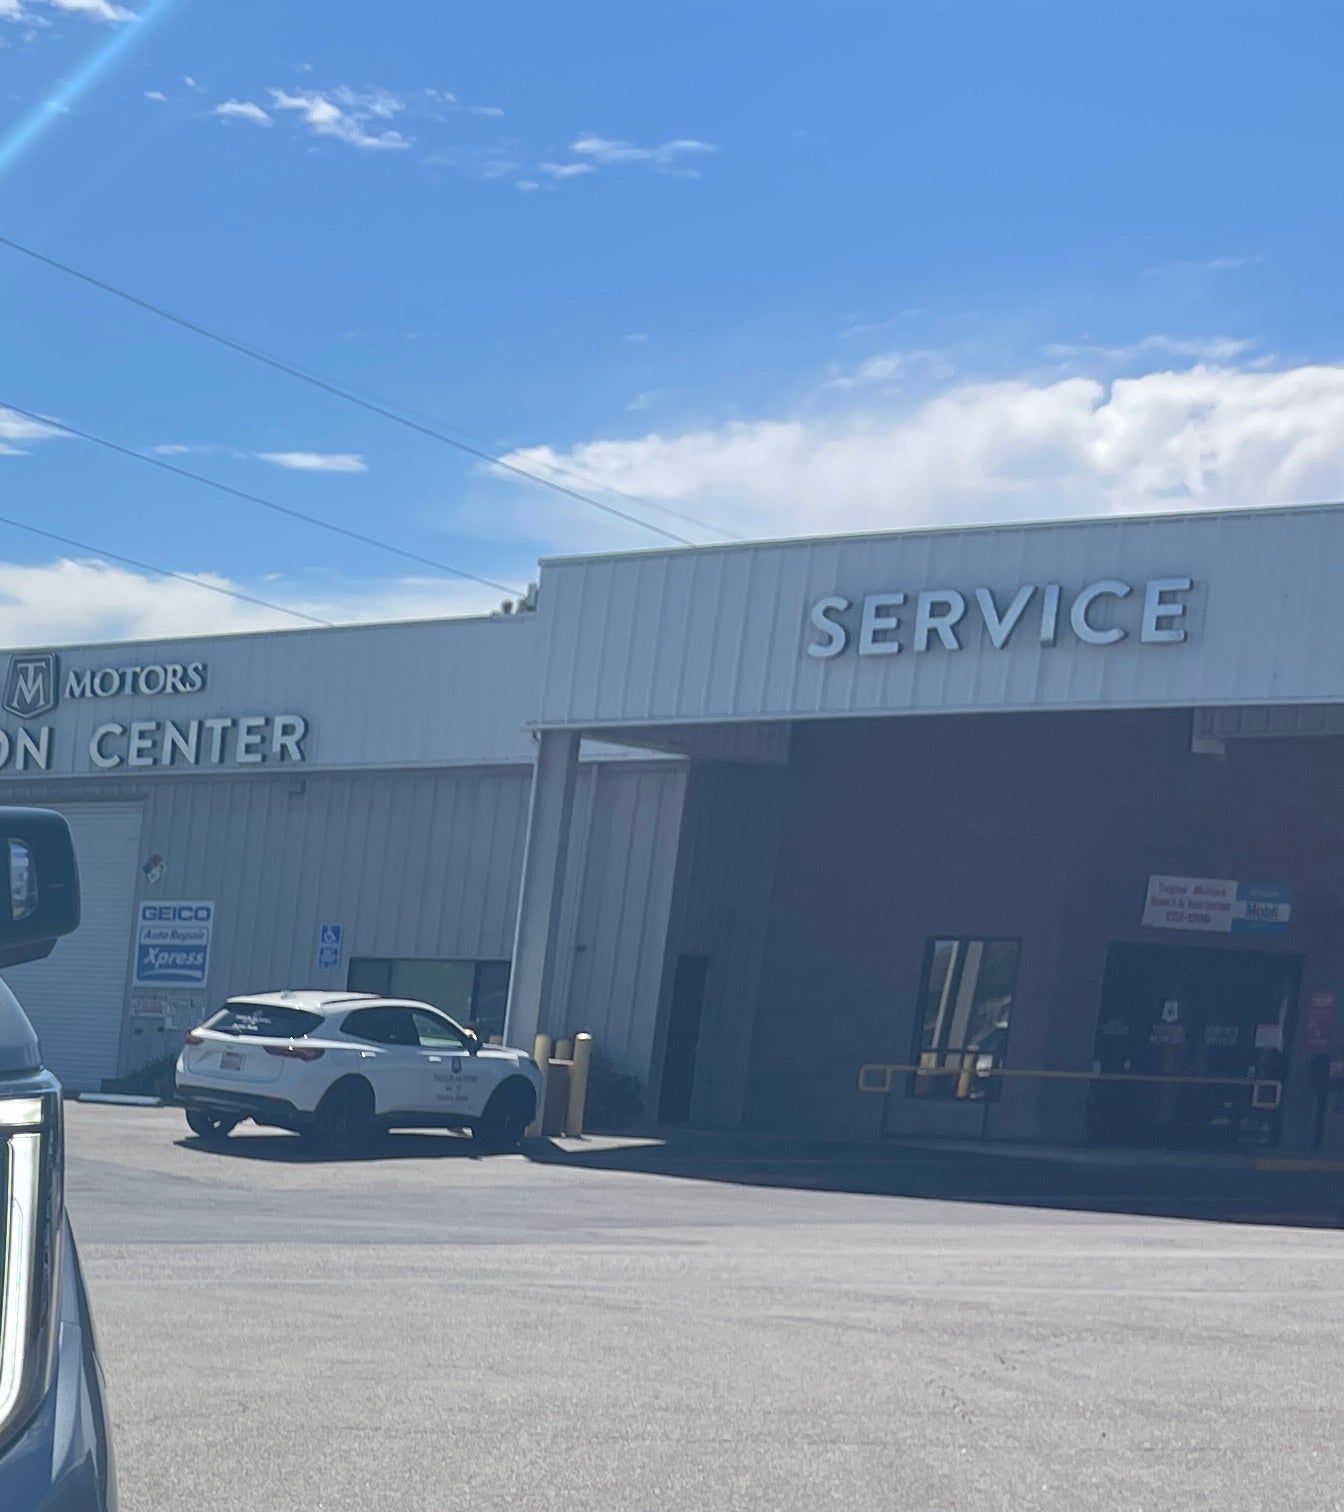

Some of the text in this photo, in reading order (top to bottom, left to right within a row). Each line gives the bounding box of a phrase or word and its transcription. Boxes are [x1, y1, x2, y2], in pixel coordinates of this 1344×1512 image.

[806, 576, 1194, 659] SERVICE
[63, 661, 208, 700] MOTORS
[88, 714, 309, 769] CENTER
[141, 906, 212, 922] GEICO
[143, 929, 170, 941] Auto
[143, 946, 204, 969] Xpress
